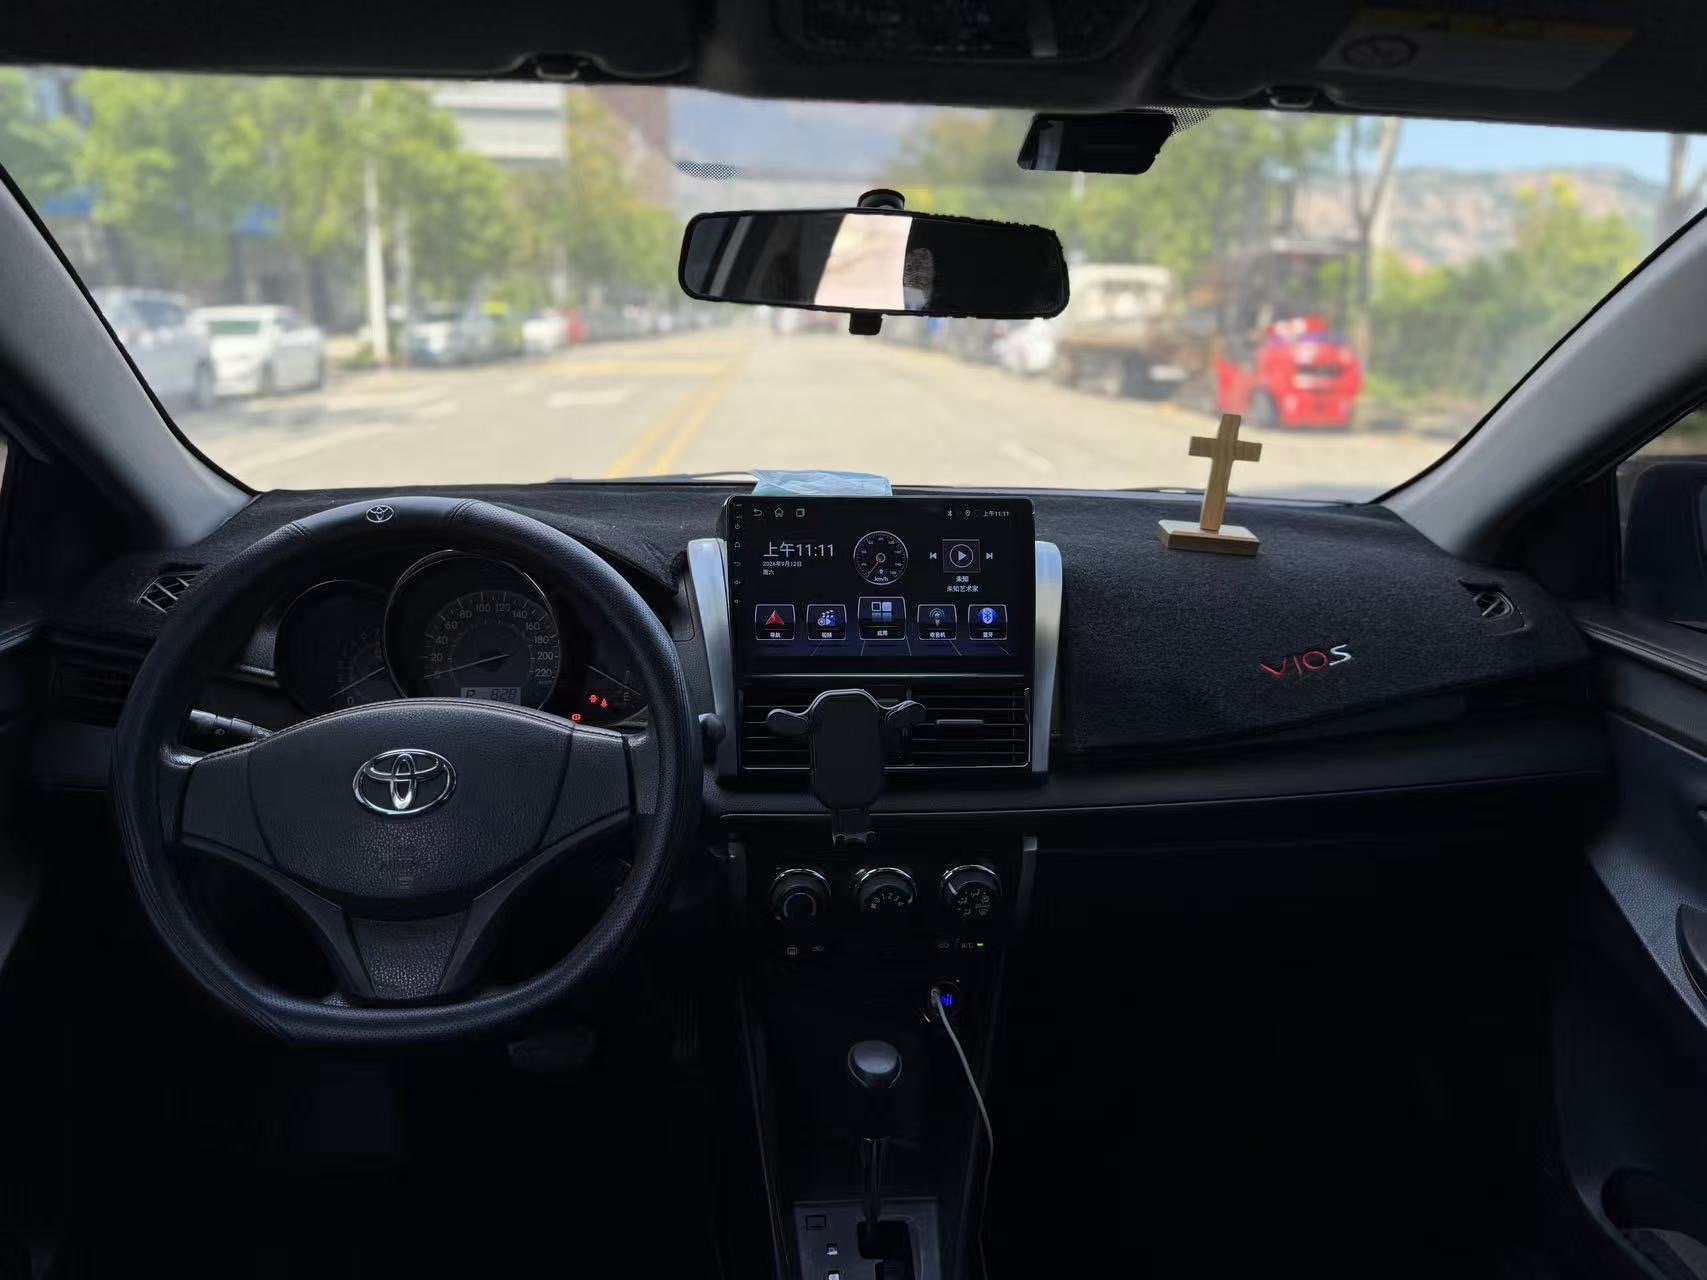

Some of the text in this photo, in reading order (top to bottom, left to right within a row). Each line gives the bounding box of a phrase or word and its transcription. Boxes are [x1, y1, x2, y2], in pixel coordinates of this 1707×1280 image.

[763, 542, 834, 558] 上午11:11
[762, 560, 802, 568] 2026年9月12日
[476, 604, 491, 612] 100
[496, 604, 510, 612] 120
[459, 610, 472, 619] 80
[513, 610, 527, 619] 140
[444, 621, 458, 630] 60
[526, 622, 540, 630] 160
[436, 636, 448, 644] 40
[535, 636, 549, 644] 180
[432, 652, 443, 662] 20
[538, 652, 553, 660] 200
[1259, 644, 1352, 677] VIOS
[536, 668, 552, 677] 220
[888, 892, 893, 900] 2
